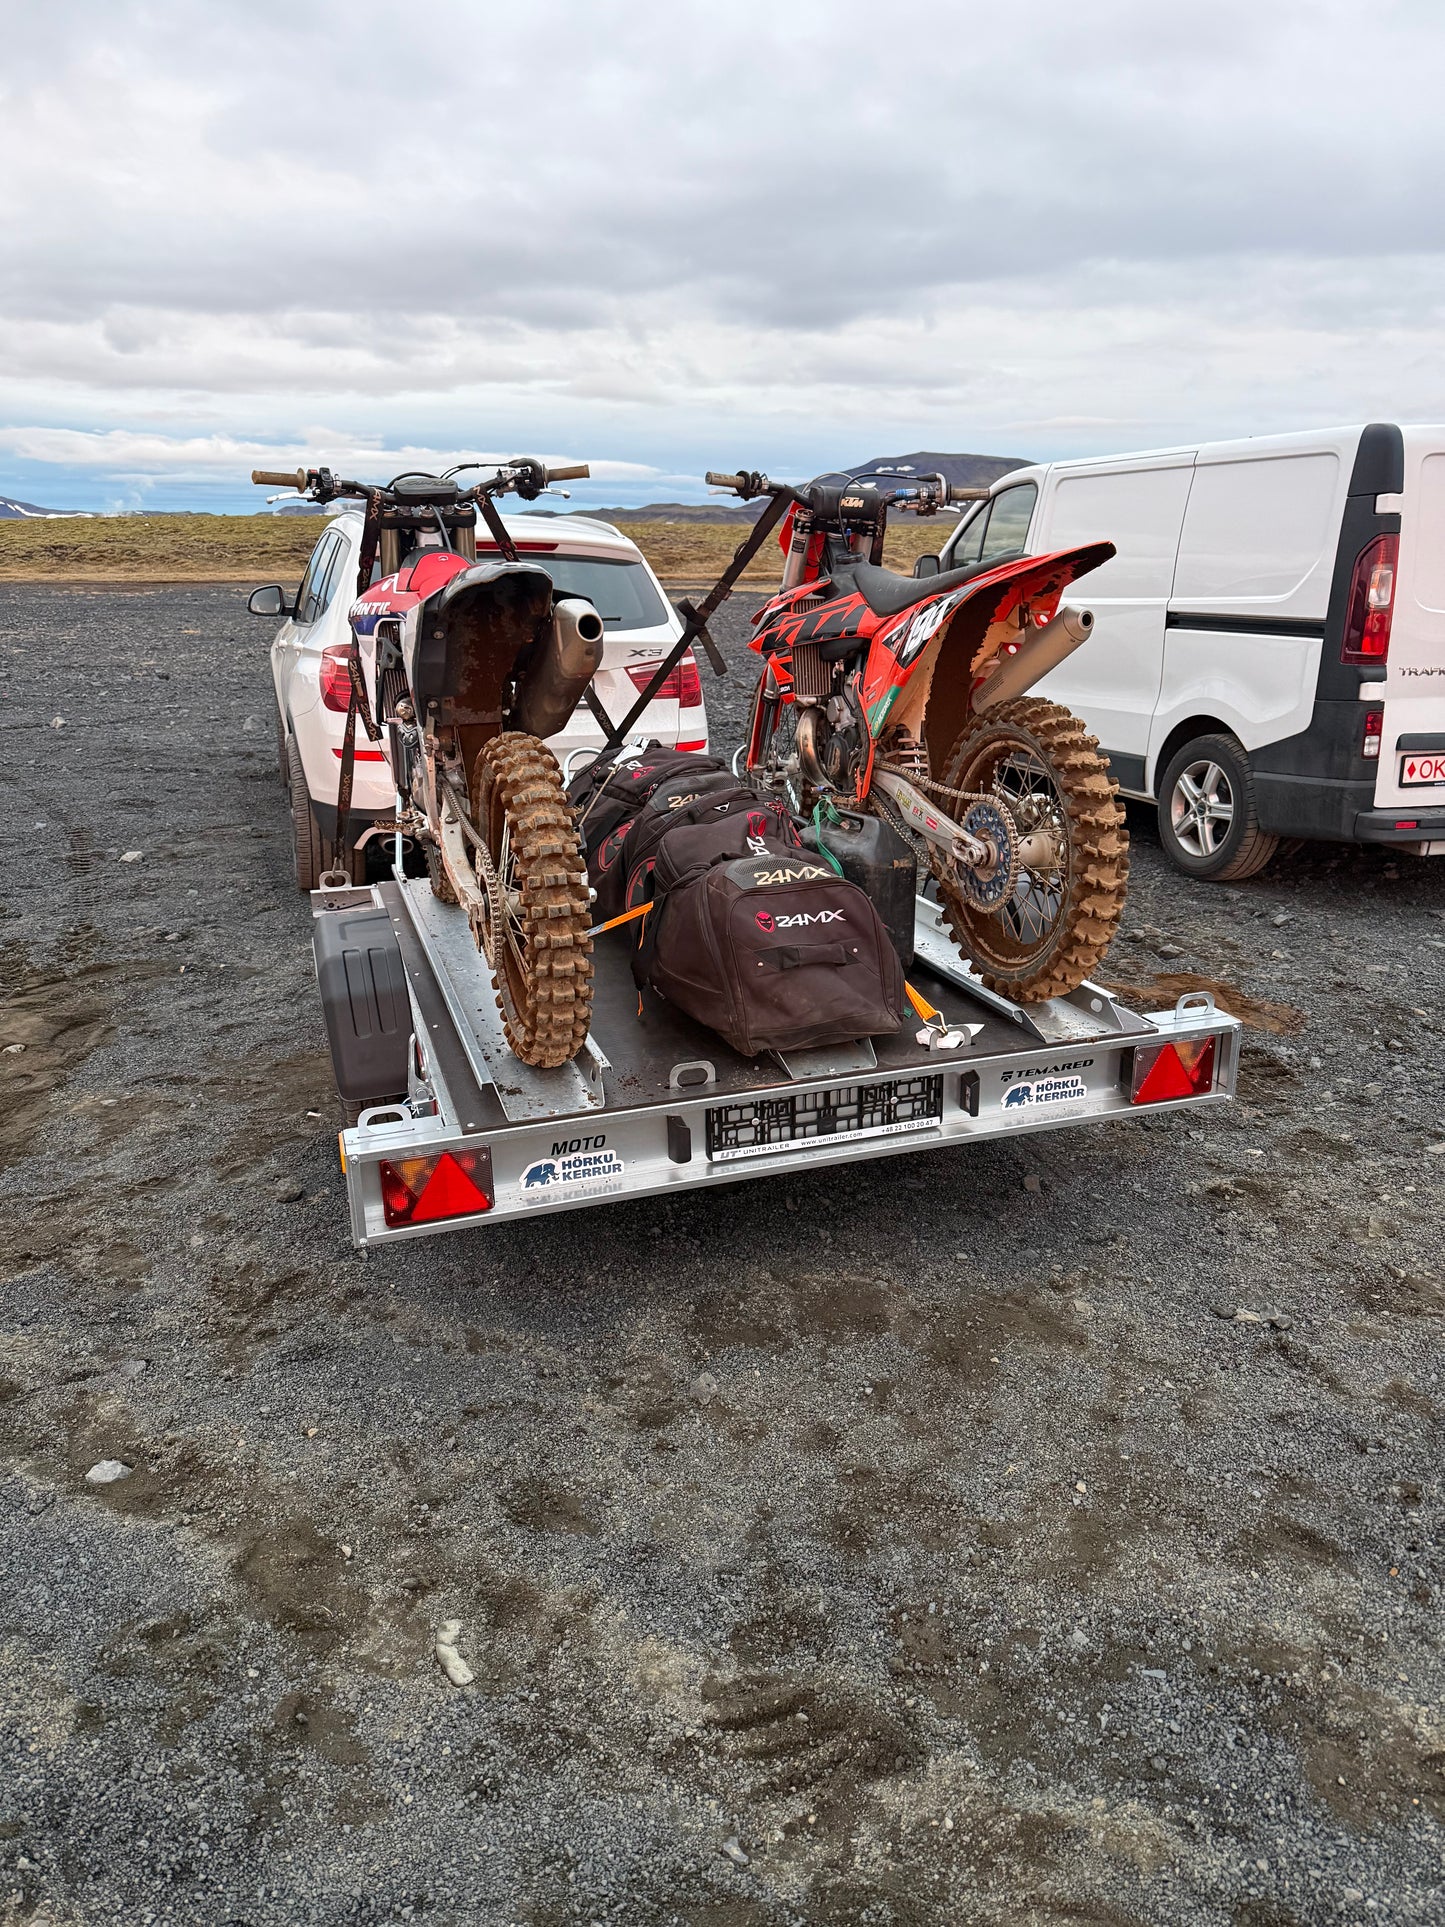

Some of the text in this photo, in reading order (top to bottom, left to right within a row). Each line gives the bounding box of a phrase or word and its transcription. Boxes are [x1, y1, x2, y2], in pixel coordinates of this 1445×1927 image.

[841, 497, 864, 508] KTM
[627, 648, 663, 658] X3
[746, 836, 771, 857] 24
[753, 866, 831, 886] 24MX
[775, 908, 847, 928] 24MX
[1016, 1059, 1094, 1078] TEMARED
[1035, 1088, 1085, 1103] KERRUR
[1036, 1079, 1079, 1093] HÖRKU
[551, 1134, 606, 1156] MOTO
[743, 1143, 790, 1155] UNITRAILER
[800, 1131, 863, 1146] www.unitrailer.com
[561, 1153, 613, 1170] HÖRKU
[562, 1163, 622, 1182] KERRUR
